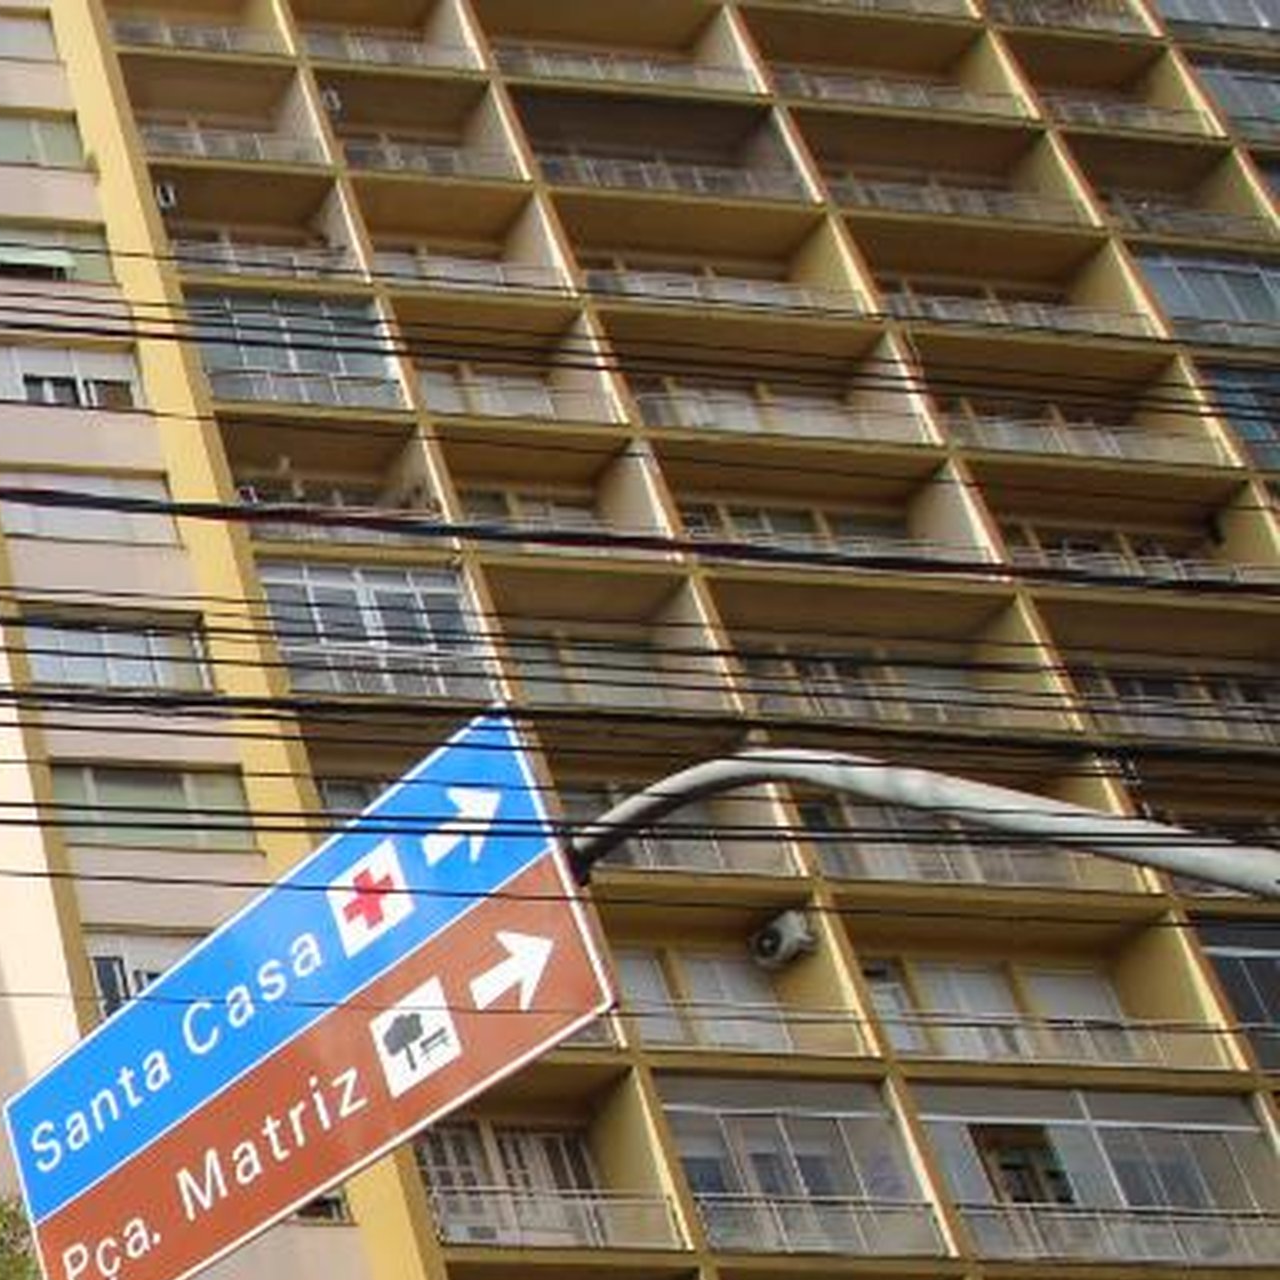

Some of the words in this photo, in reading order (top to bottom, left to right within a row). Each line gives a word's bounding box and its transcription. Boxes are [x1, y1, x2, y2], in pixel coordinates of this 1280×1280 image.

[30, 1049, 172, 1172] Santa
[182, 932, 323, 1055] Casa
[176, 1066, 368, 1221] Matriz
